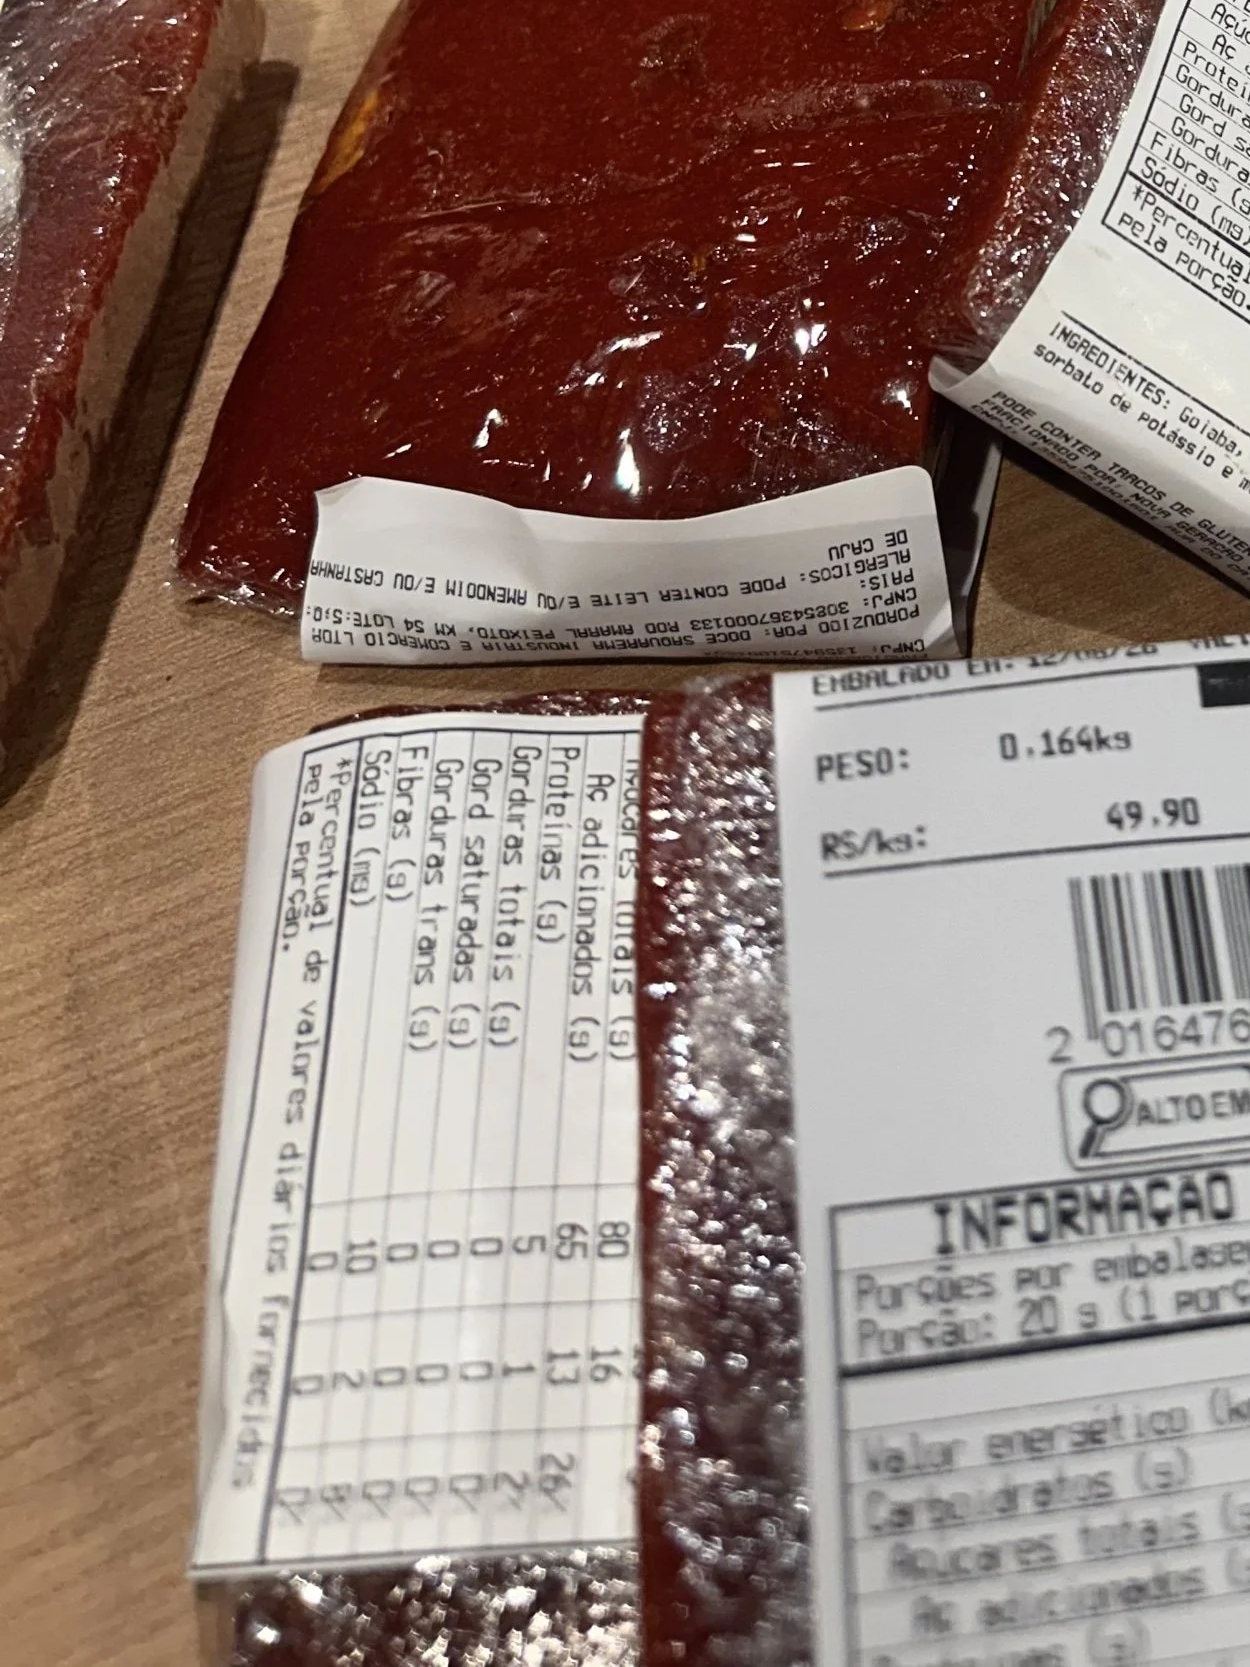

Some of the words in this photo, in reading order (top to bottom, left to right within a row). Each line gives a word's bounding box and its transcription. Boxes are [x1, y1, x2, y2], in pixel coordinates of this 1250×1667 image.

[1179, 93, 1228, 138] Gord
[1150, 130, 1220, 193] Fibras
[1140, 155, 1200, 212] Sódio
[1049, 321, 1170, 410] INGREDIENTES:
[1178, 406, 1243, 457] Goiaba,
[827, 537, 875, 562] CAJU
[884, 528, 909, 548] DE
[308, 557, 384, 587] CASTANHA
[393, 572, 436, 594] E/OU
[799, 548, 911, 584] ALERGICOS:
[859, 567, 915, 591] PAIS:
[445, 579, 528, 606] AMENDOIM
[537, 592, 581, 610] E/OU
[589, 591, 649, 607] LEITE
[658, 584, 729, 603] CONTER
[739, 575, 787, 595] PODE
[863, 586, 918, 609] CNPJ:
[311, 627, 355, 646] LTDA
[364, 631, 451, 652] COMERCIO
[704, 629, 752, 645] DOCE
[764, 623, 808, 639] POR:
[812, 663, 951, 698] EMBALADO
[815, 747, 909, 782] PESO:
[357, 749, 393, 830] Sódio
[391, 745, 430, 841] Fibras
[467, 758, 504, 820] Gord
[501, 745, 543, 866] Gorduras
[423, 758, 465, 886] Gorduras
[539, 746, 581, 881] Proteínas
[1106, 797, 1201, 831] 49,90
[451, 835, 489, 984] saturadas
[571, 817, 607, 997] adicionados
[413, 904, 449, 986] trans
[491, 884, 527, 982] totais
[1131, 1093, 1208, 1127] ALTO
[928, 1171, 1234, 1257] INFORMAÇÃO
